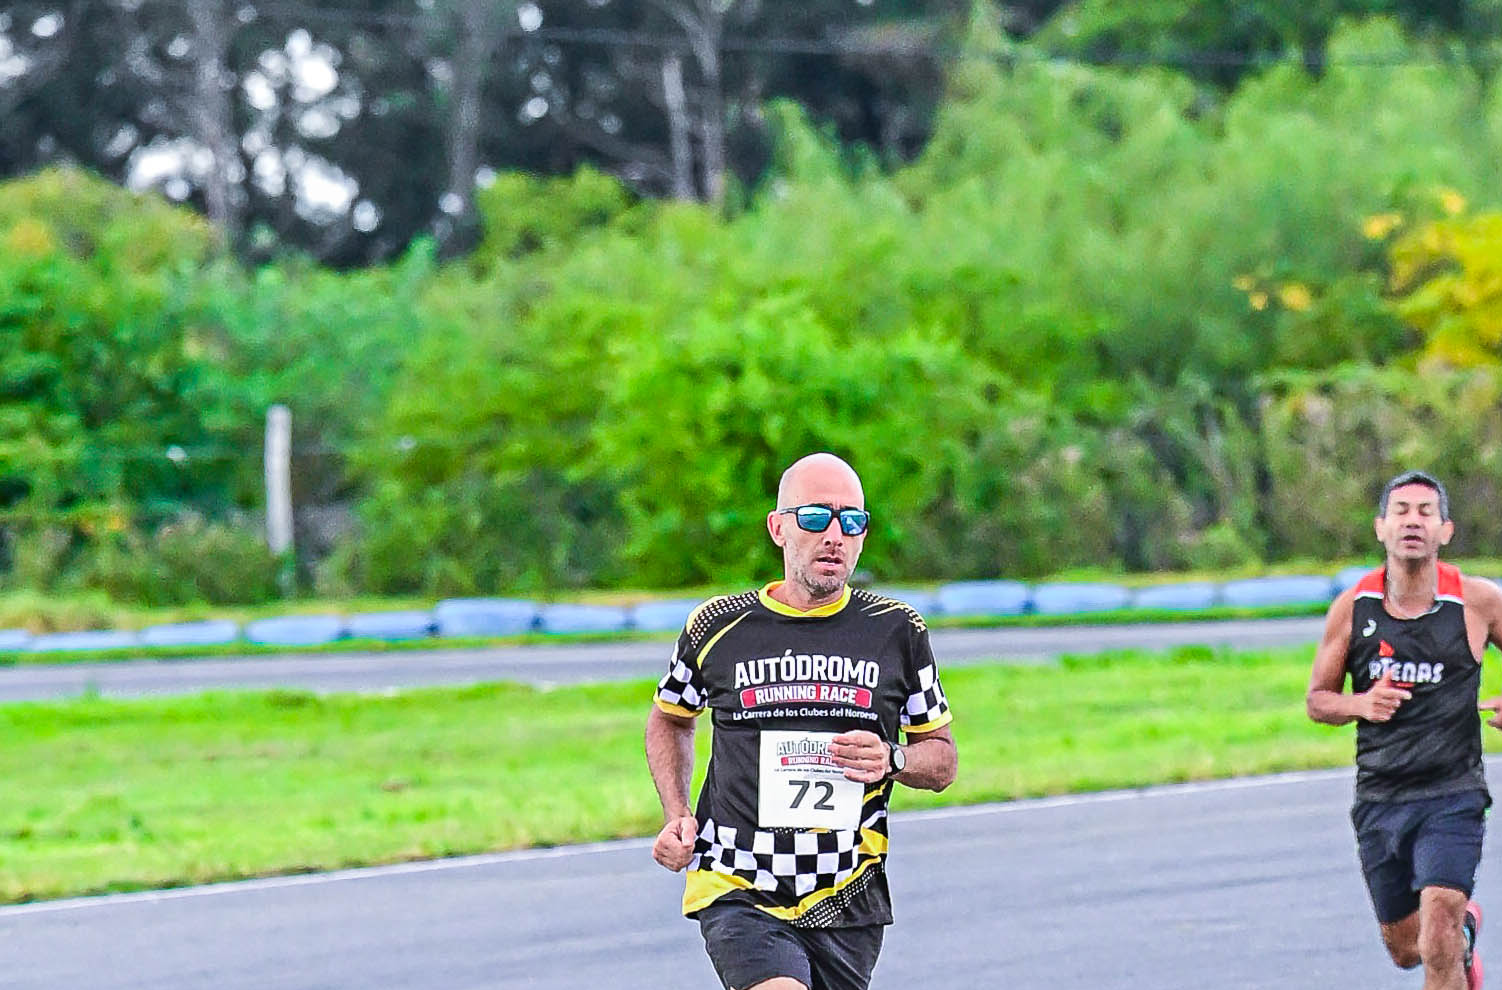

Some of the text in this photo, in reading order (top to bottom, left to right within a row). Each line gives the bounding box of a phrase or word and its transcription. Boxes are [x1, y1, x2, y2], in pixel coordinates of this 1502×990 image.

[734, 648, 880, 689] AUTÓDROMO
[754, 686, 858, 705] RUNNING RACE
[732, 711, 742, 720] La
[742, 710, 772, 719] Carrera
[773, 708, 784, 717] de
[785, 707, 798, 717] los
[799, 707, 828, 716] Clubes
[830, 707, 843, 717] del
[788, 780, 835, 811] 72
